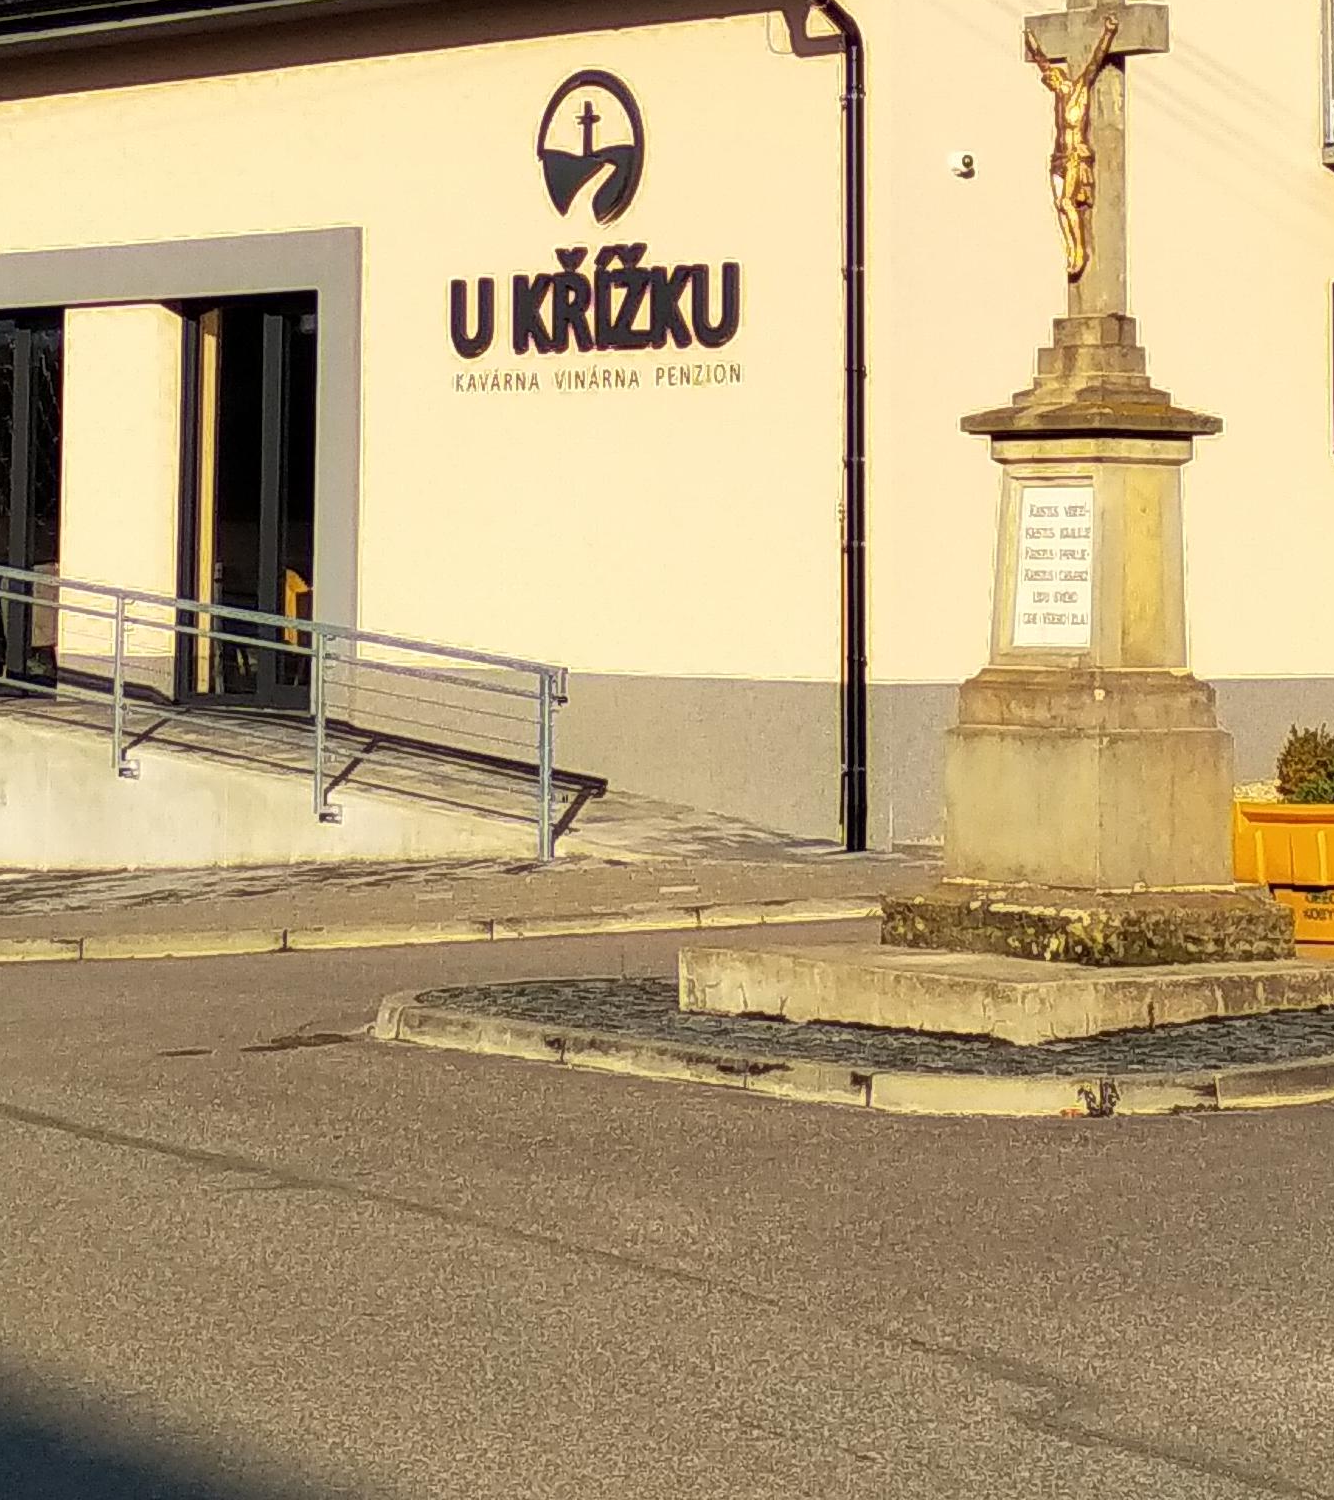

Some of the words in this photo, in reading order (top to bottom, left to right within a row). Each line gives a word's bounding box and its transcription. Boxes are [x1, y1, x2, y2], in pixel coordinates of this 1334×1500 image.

[450, 276, 495, 360] U
[512, 242, 741, 356] KŘÍŽKU
[454, 368, 540, 393] KAVÁRNA
[554, 365, 640, 391] VINÁRNA
[655, 363, 741, 387] PENZION
